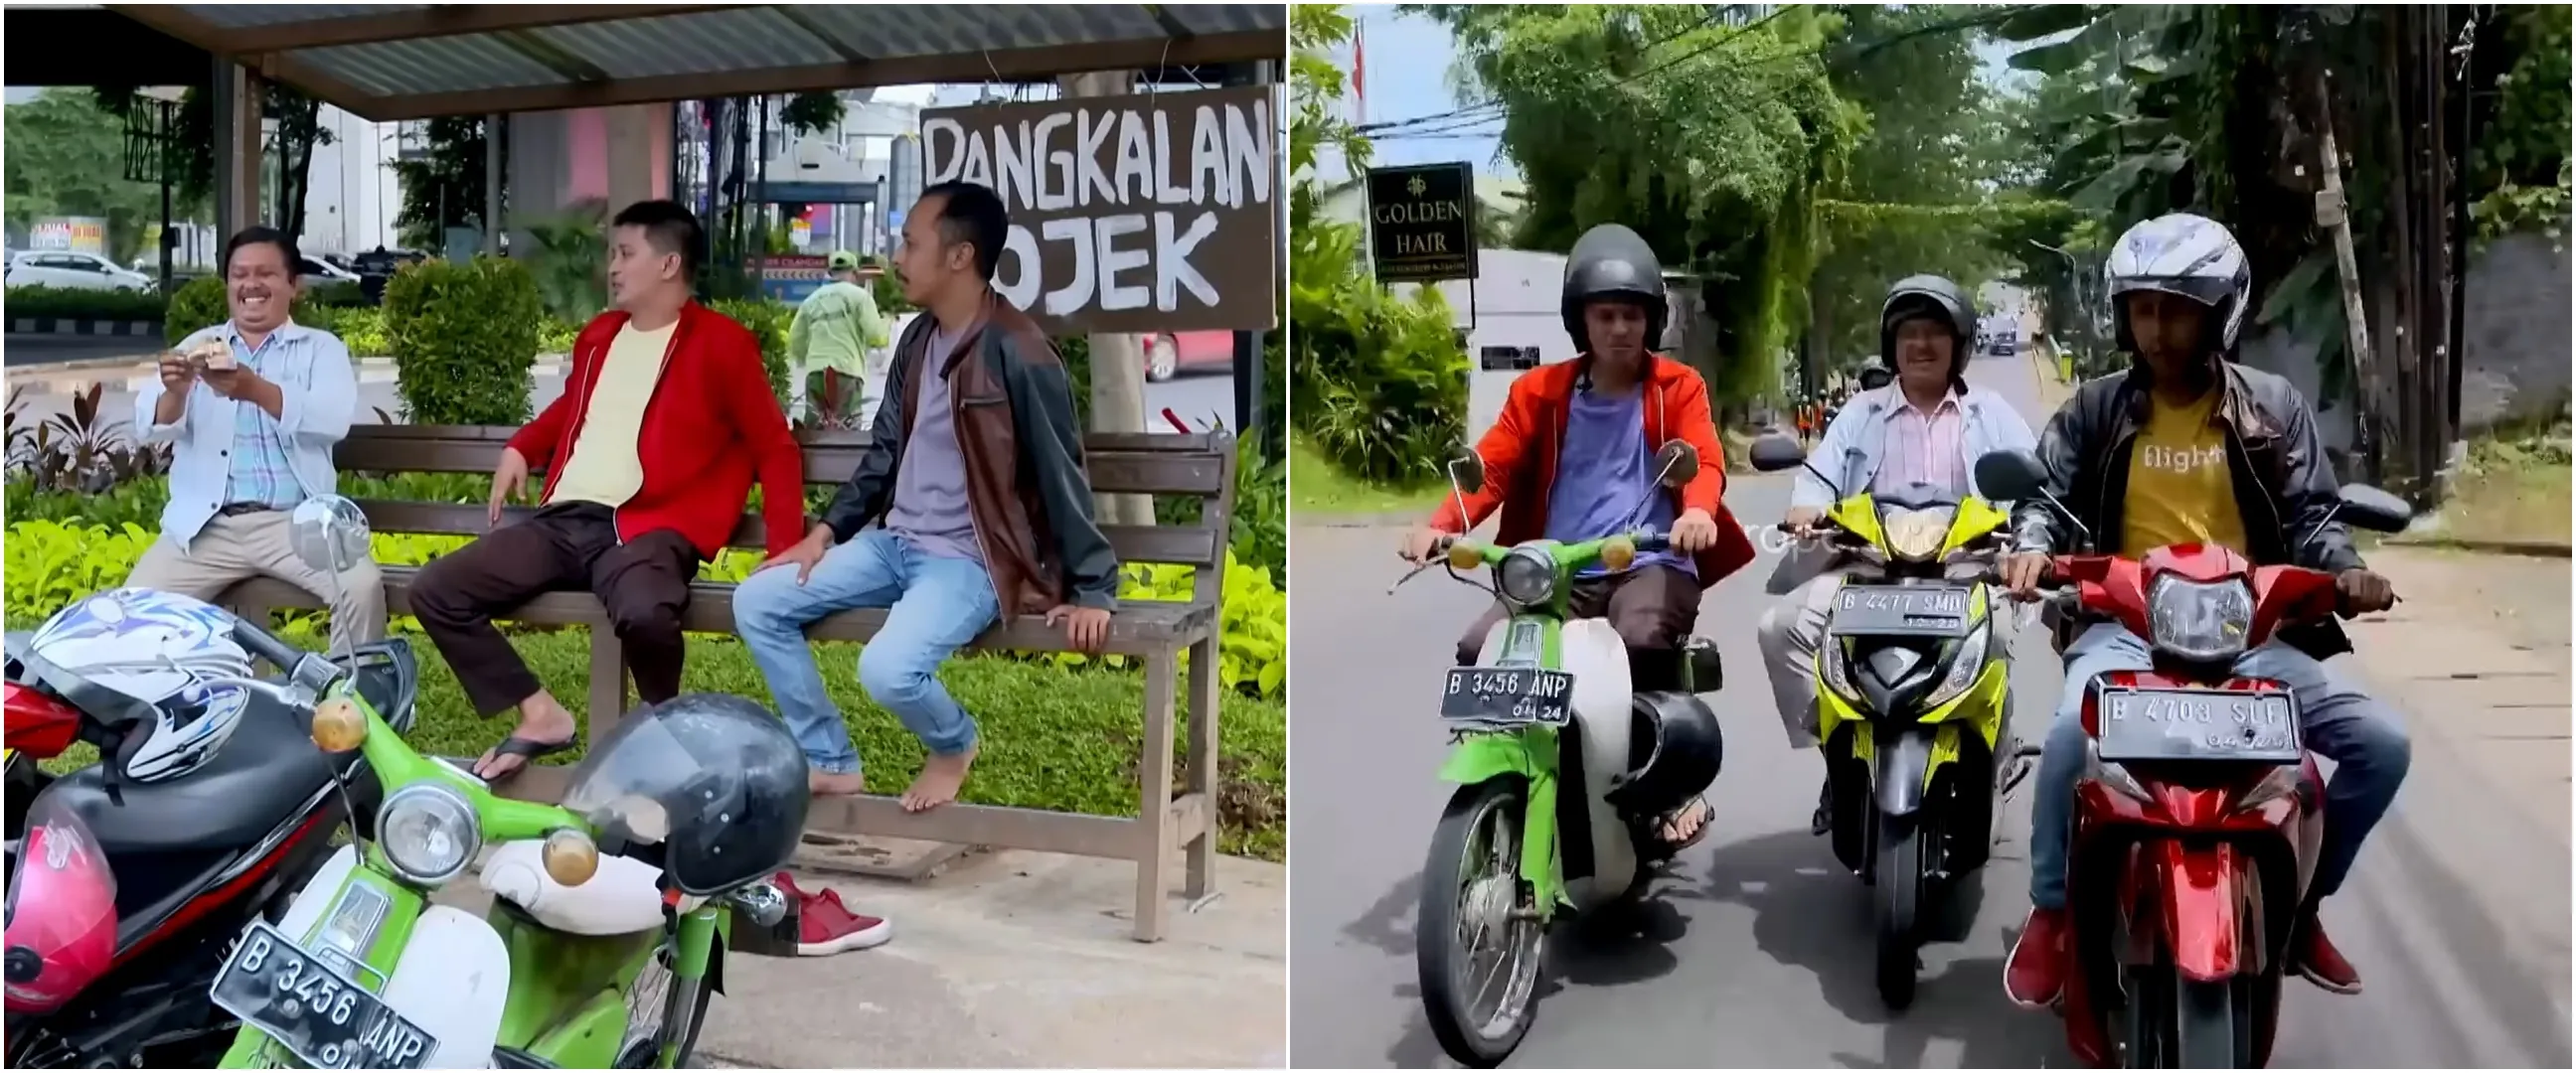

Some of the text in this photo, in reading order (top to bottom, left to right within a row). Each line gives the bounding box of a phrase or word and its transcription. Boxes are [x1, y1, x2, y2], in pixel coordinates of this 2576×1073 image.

[1374, 200, 1463, 225] GOLDEN
[1396, 231, 1447, 254] HAIR
[992, 211, 1220, 316] OJEK
[1844, 593, 1855, 610] B
[1866, 594, 1913, 612] 4477
[1449, 673, 1567, 697] B 3456 ANP
[2112, 698, 2128, 722] B
[2145, 697, 2212, 723] 4703
[241, 937, 422, 1066] B 3456 ANP
